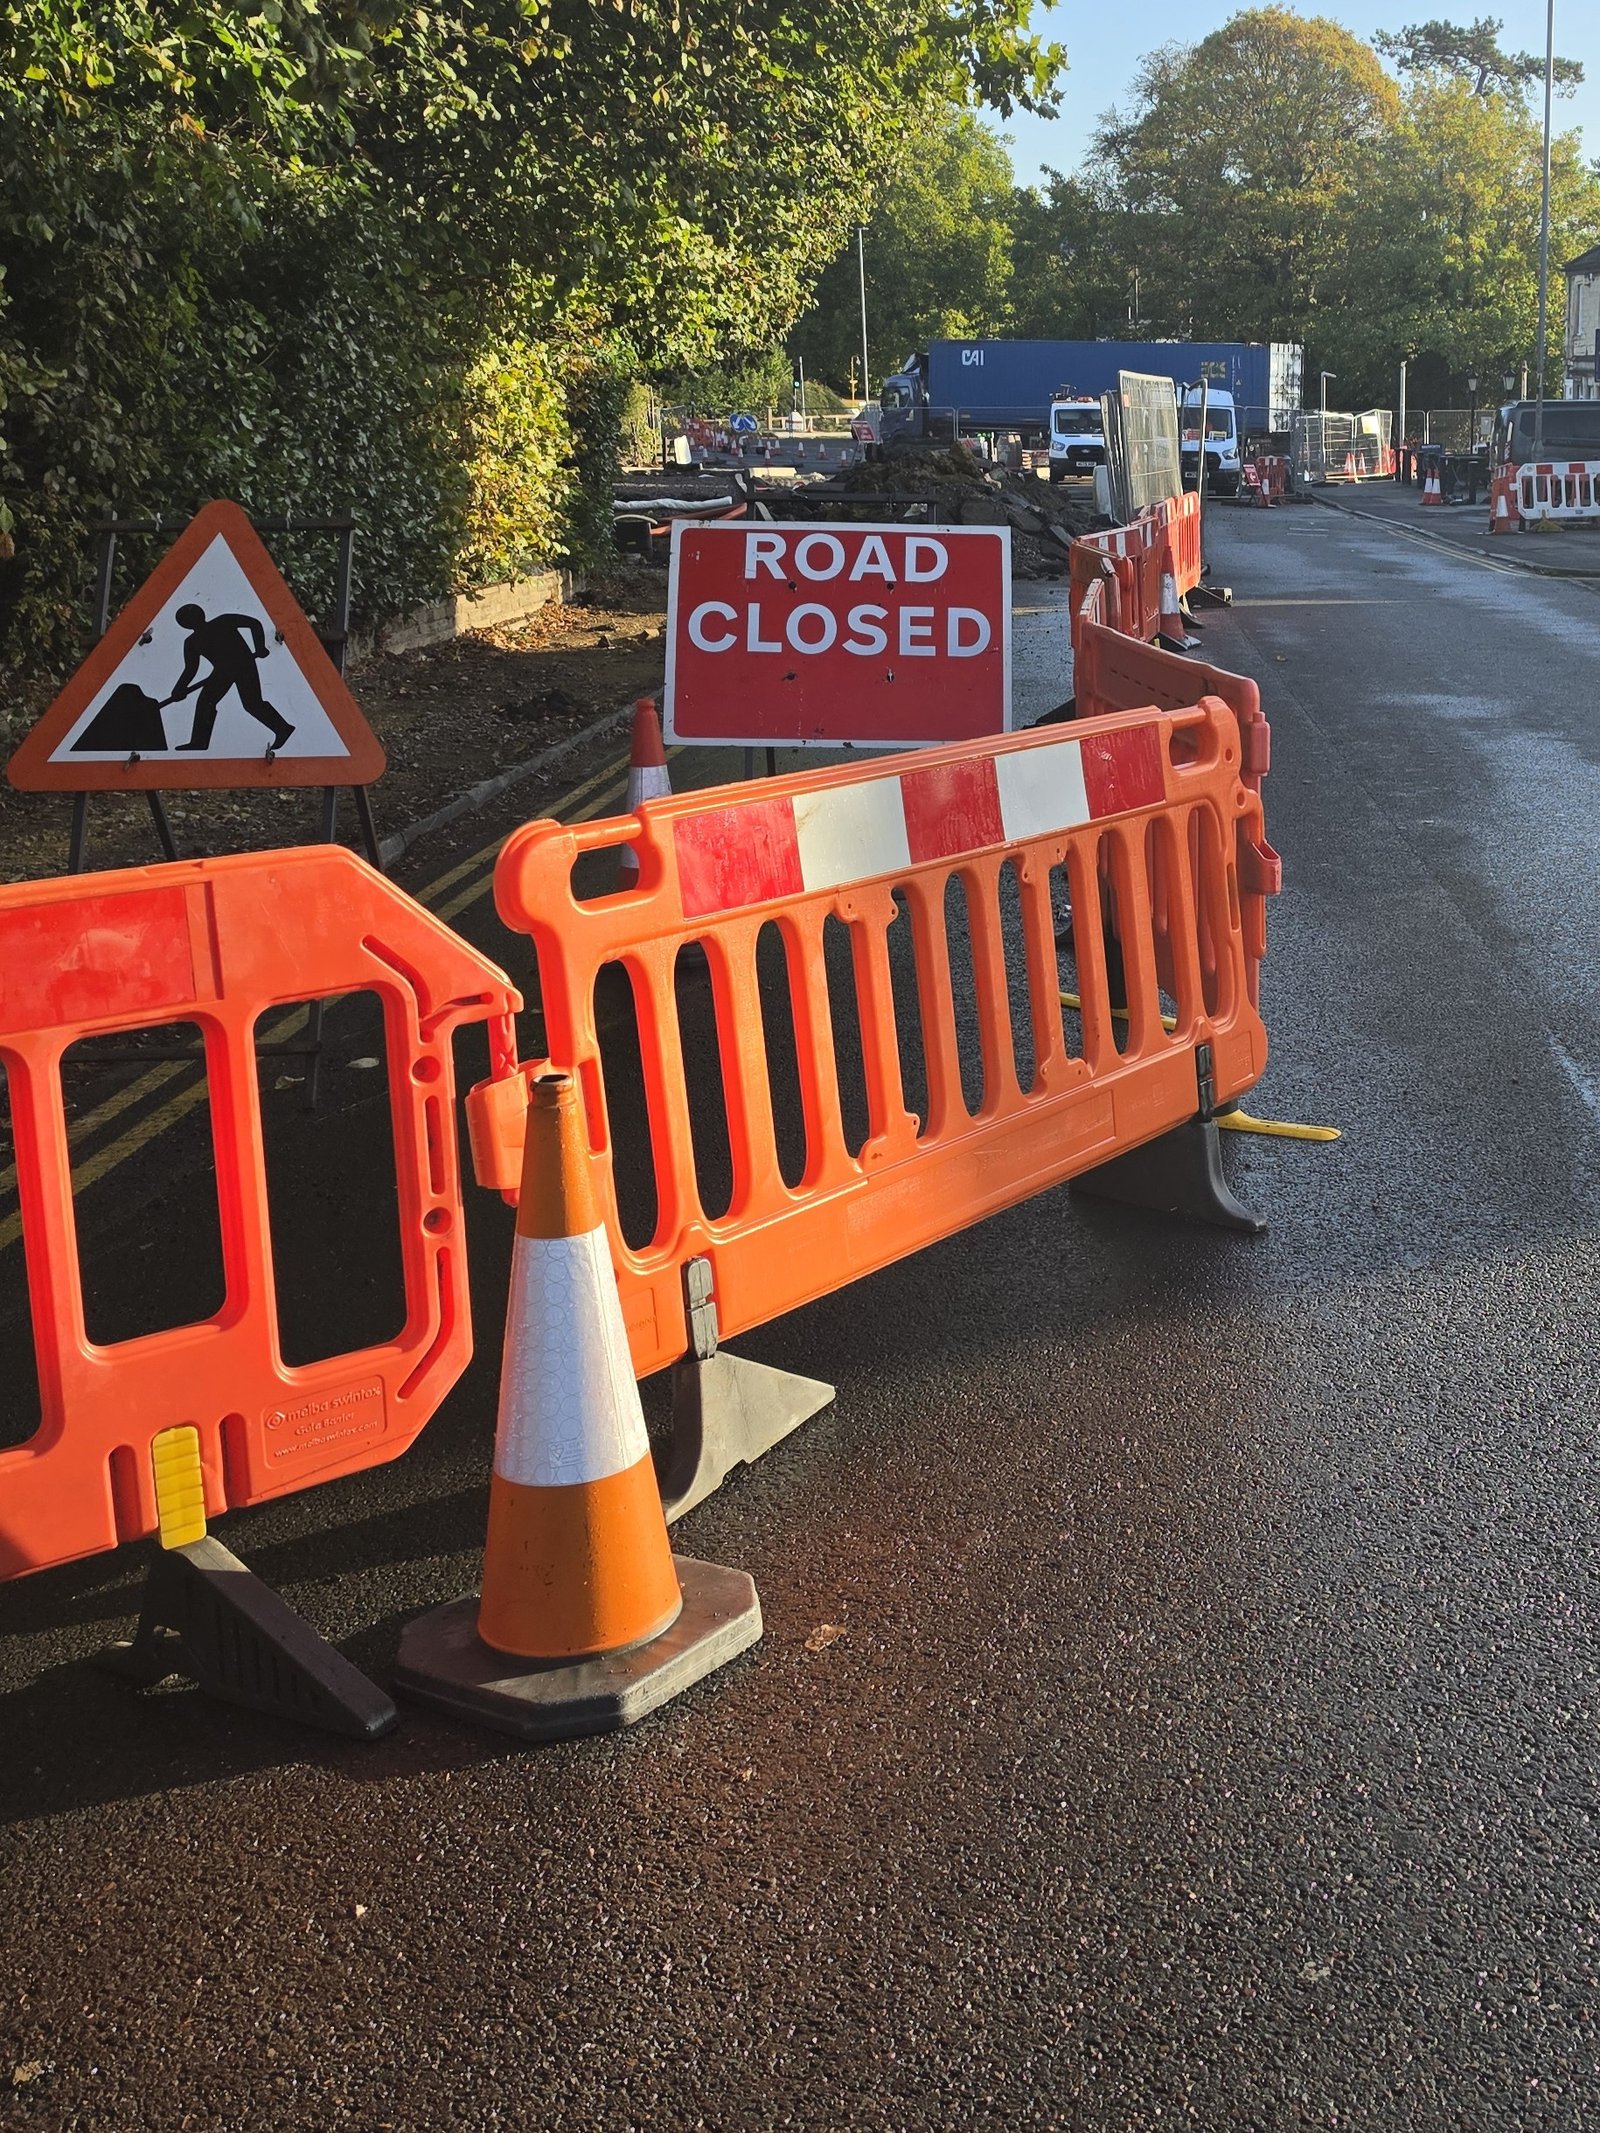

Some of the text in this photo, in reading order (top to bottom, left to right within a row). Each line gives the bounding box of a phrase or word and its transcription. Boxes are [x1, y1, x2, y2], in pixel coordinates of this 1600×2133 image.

[961, 349, 984, 366] CAI
[744, 532, 949, 583] ROAD
[687, 600, 992, 658] CLOSED
